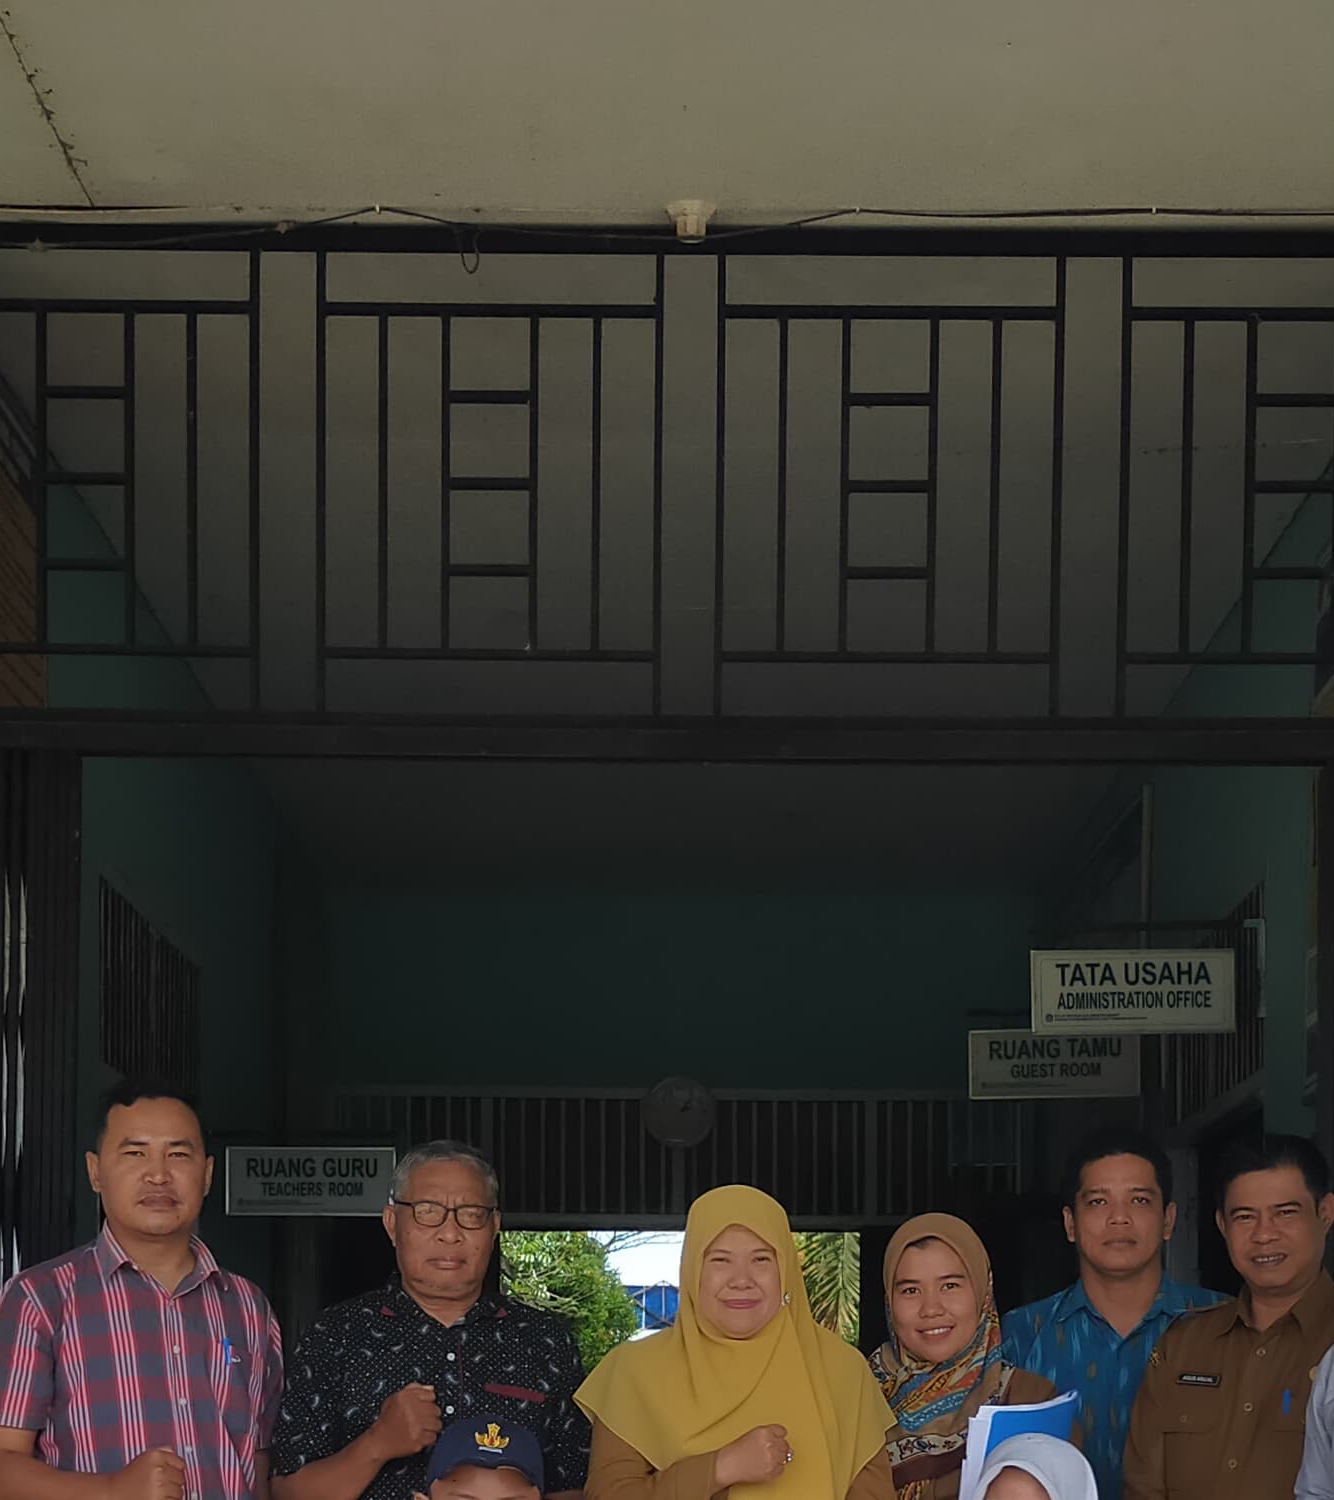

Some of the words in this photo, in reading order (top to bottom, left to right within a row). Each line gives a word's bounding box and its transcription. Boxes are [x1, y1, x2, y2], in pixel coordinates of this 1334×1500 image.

[1055, 963, 1117, 987] TATA
[1124, 961, 1212, 986] USAHA
[1057, 991, 1163, 1010] ADMINISTRATION
[1166, 990, 1212, 1008] OFFICE
[988, 1039, 1060, 1061] RUANG
[1068, 1037, 1122, 1058] TAMU
[1010, 1063, 1057, 1079] GUEST
[1060, 1062, 1101, 1077] ROOM
[246, 1158, 316, 1178] RUANG
[322, 1158, 378, 1178] GURU
[328, 1182, 363, 1196] ROOM
